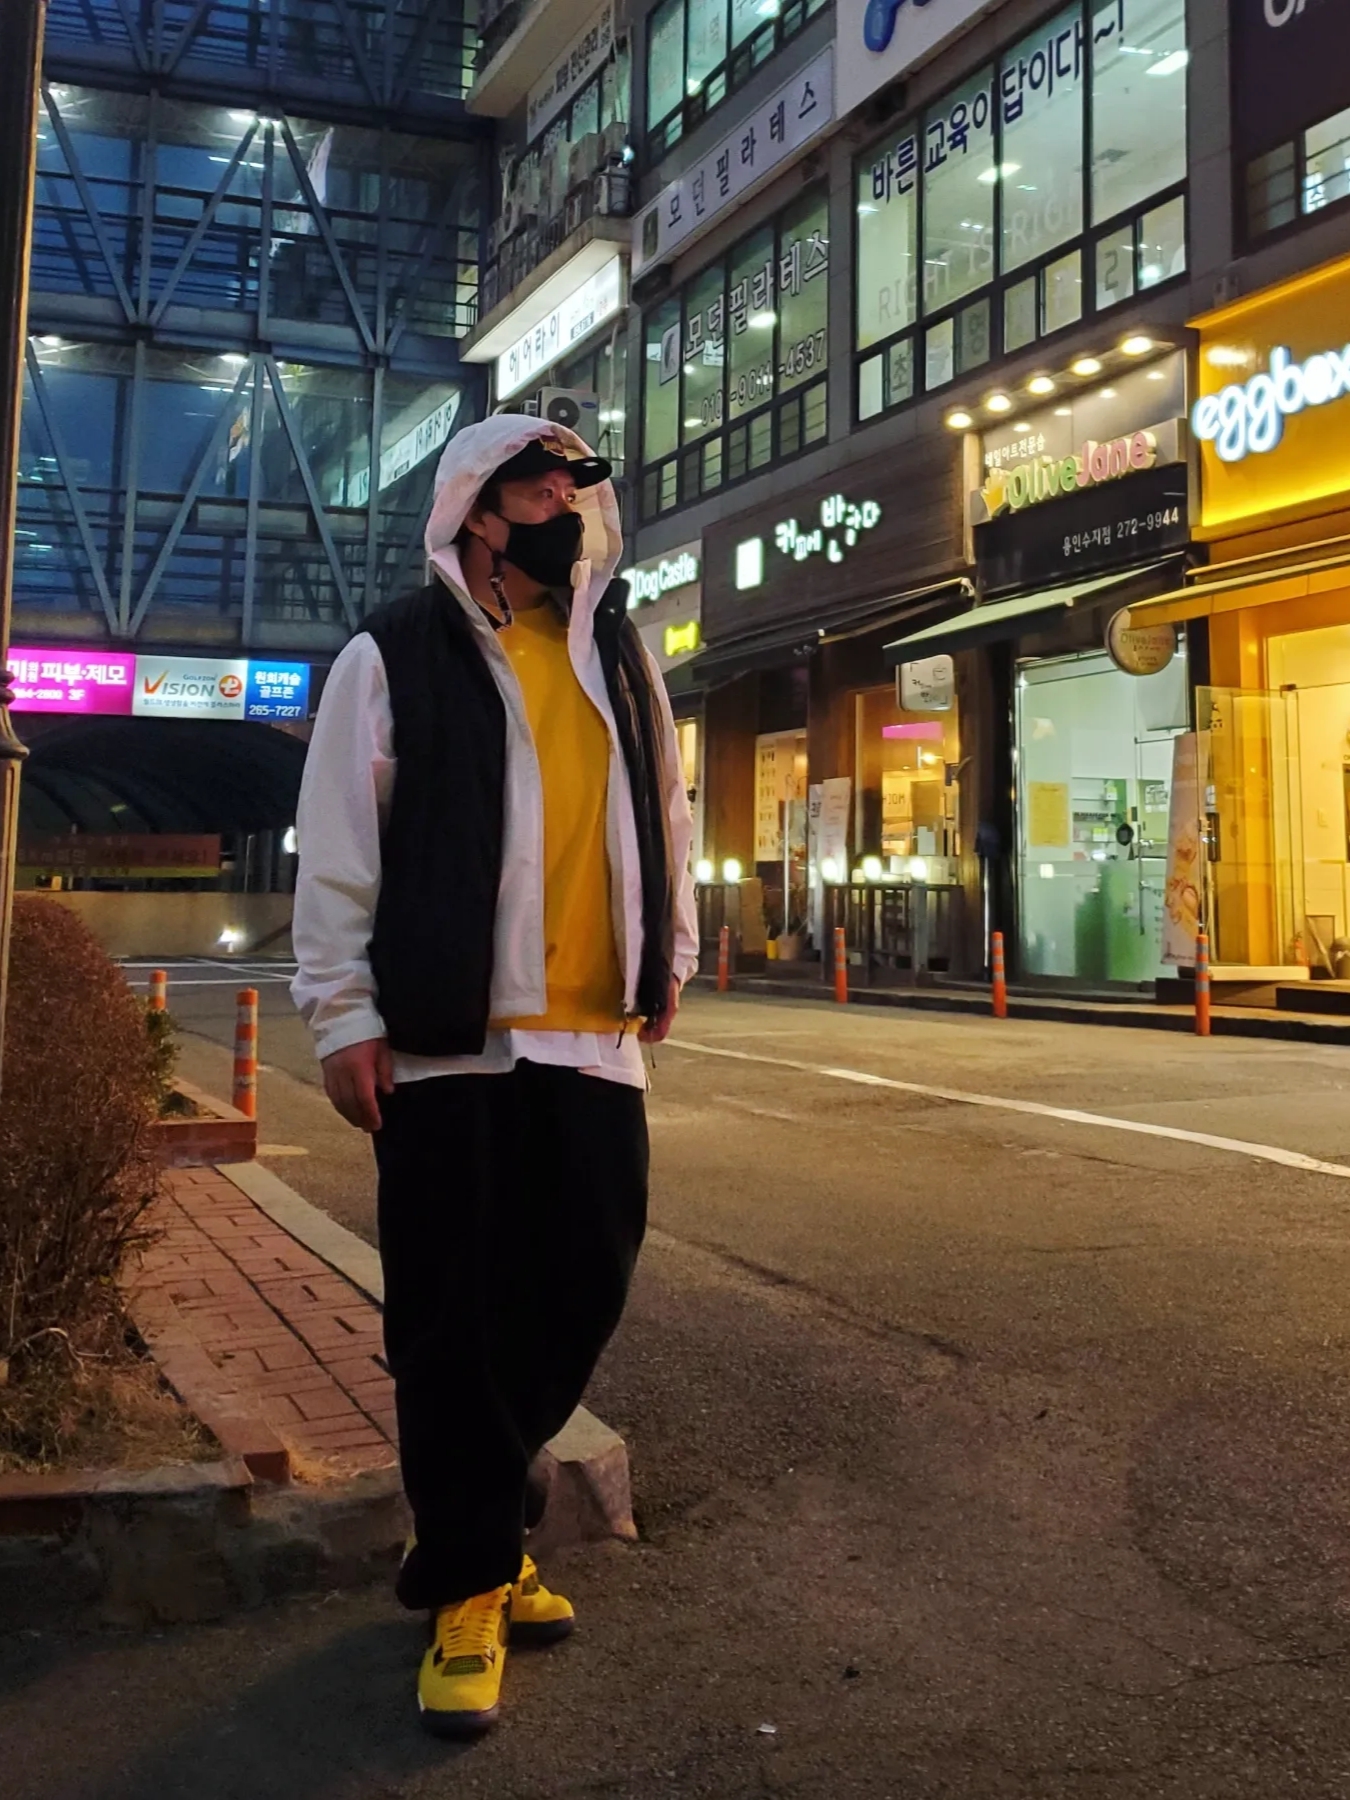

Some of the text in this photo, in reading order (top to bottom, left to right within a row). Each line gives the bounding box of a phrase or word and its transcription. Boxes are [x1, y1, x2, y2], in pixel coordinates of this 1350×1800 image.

[667, 80, 818, 230] 모던필라테스
[685, 230, 829, 361] 모던필라테스
[1191, 346, 1350, 462] eggbox
[1007, 430, 1157, 509] OliveJane
[775, 494, 882, 563] 커피에 반하다
[1062, 506, 1180, 557] 용인수지점 272-9944
[636, 552, 697, 601] Dog Castle
[144, 669, 216, 698] VISION
[248, 704, 302, 717] 265-7227
[259, 685, 295, 699] 골프존
